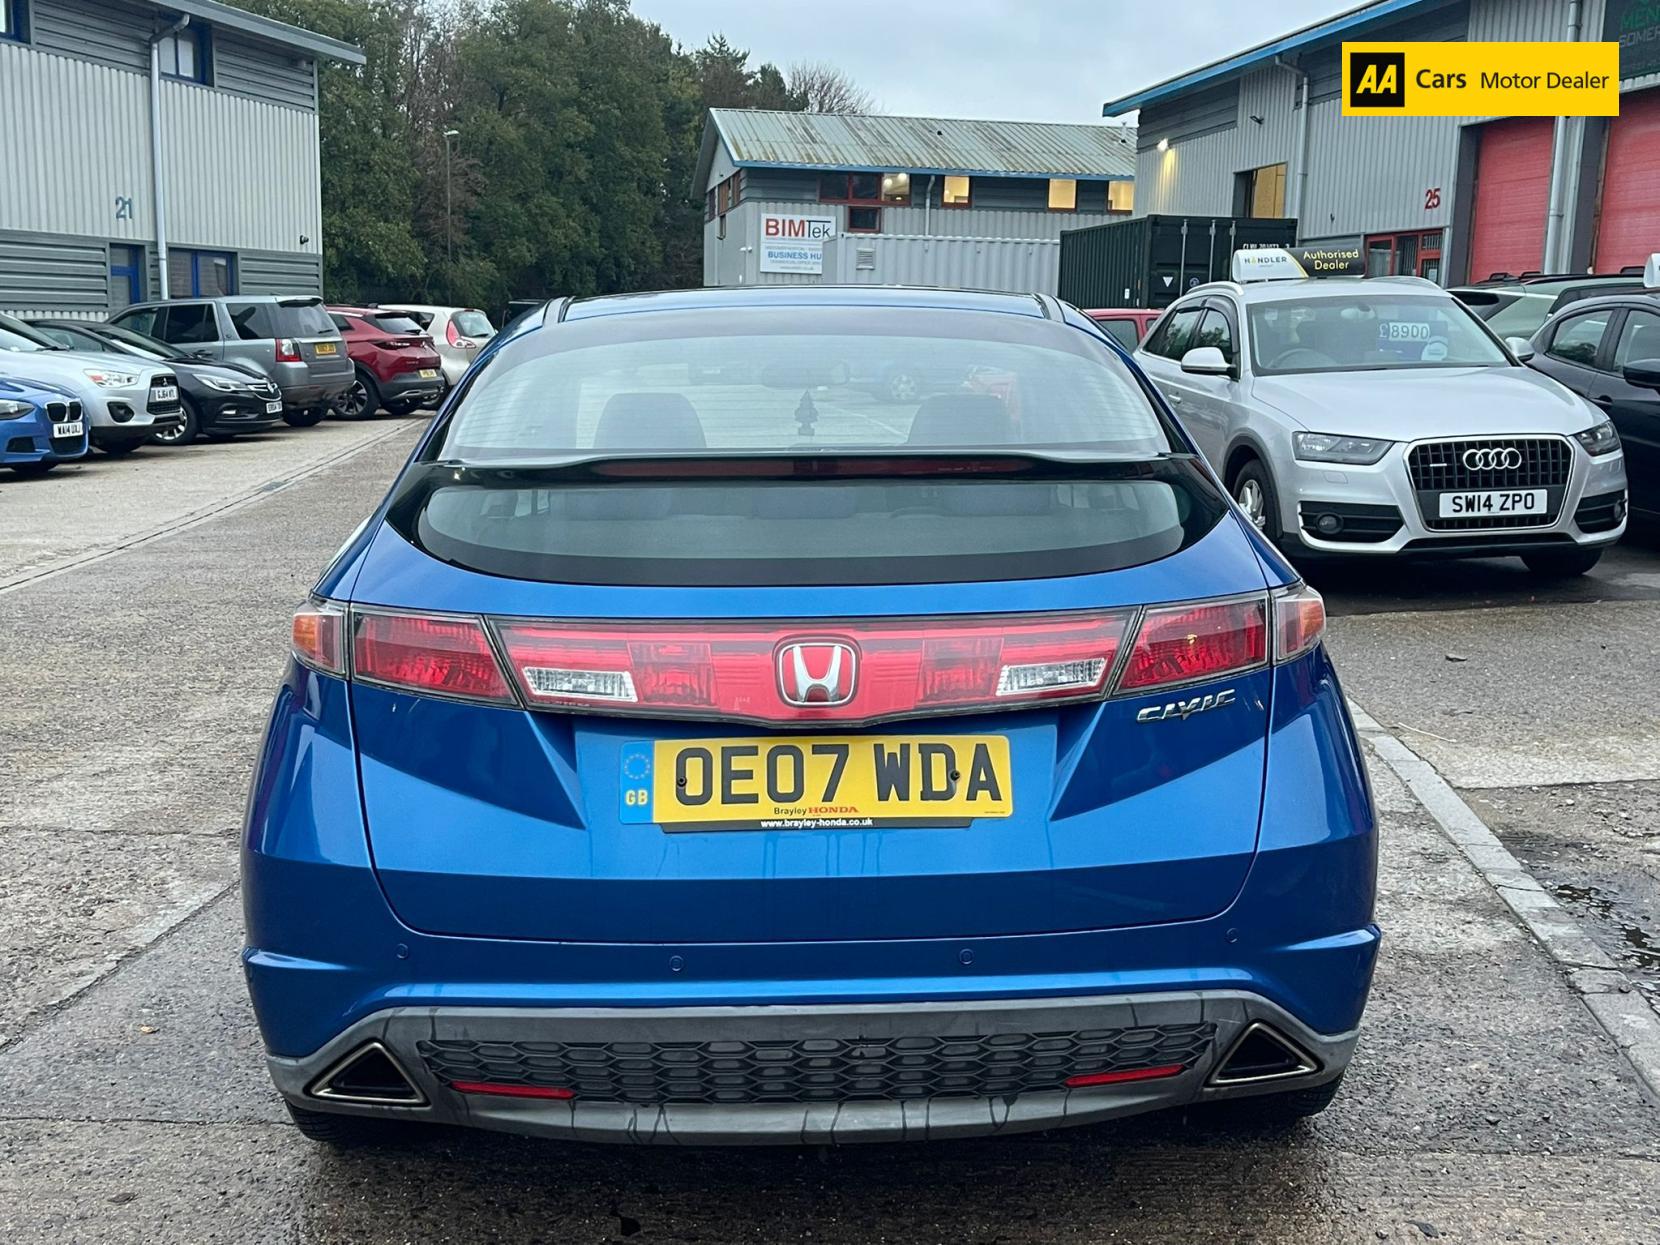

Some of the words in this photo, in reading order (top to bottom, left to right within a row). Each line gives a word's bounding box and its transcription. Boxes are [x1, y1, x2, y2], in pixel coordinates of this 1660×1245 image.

[115, 196, 132, 219] 21
[1425, 188, 1441, 209] 25
[765, 218, 832, 239] BIMTek
[768, 250, 809, 260] BUSINESS
[1303, 249, 1359, 260] Authorised
[1314, 260, 1350, 270] Dealer
[1452, 494, 1493, 513] SW14
[1500, 492, 1535, 511] ZPO
[1137, 688, 1237, 721] CIVIC
[675, 743, 850, 806] OE07
[873, 743, 1003, 802] WDA
[625, 789, 648, 806] GB
[773, 807, 808, 816] Brayley
[808, 806, 859, 814] HONDA
[760, 817, 873, 828] www.brayley-honda.co.uk
